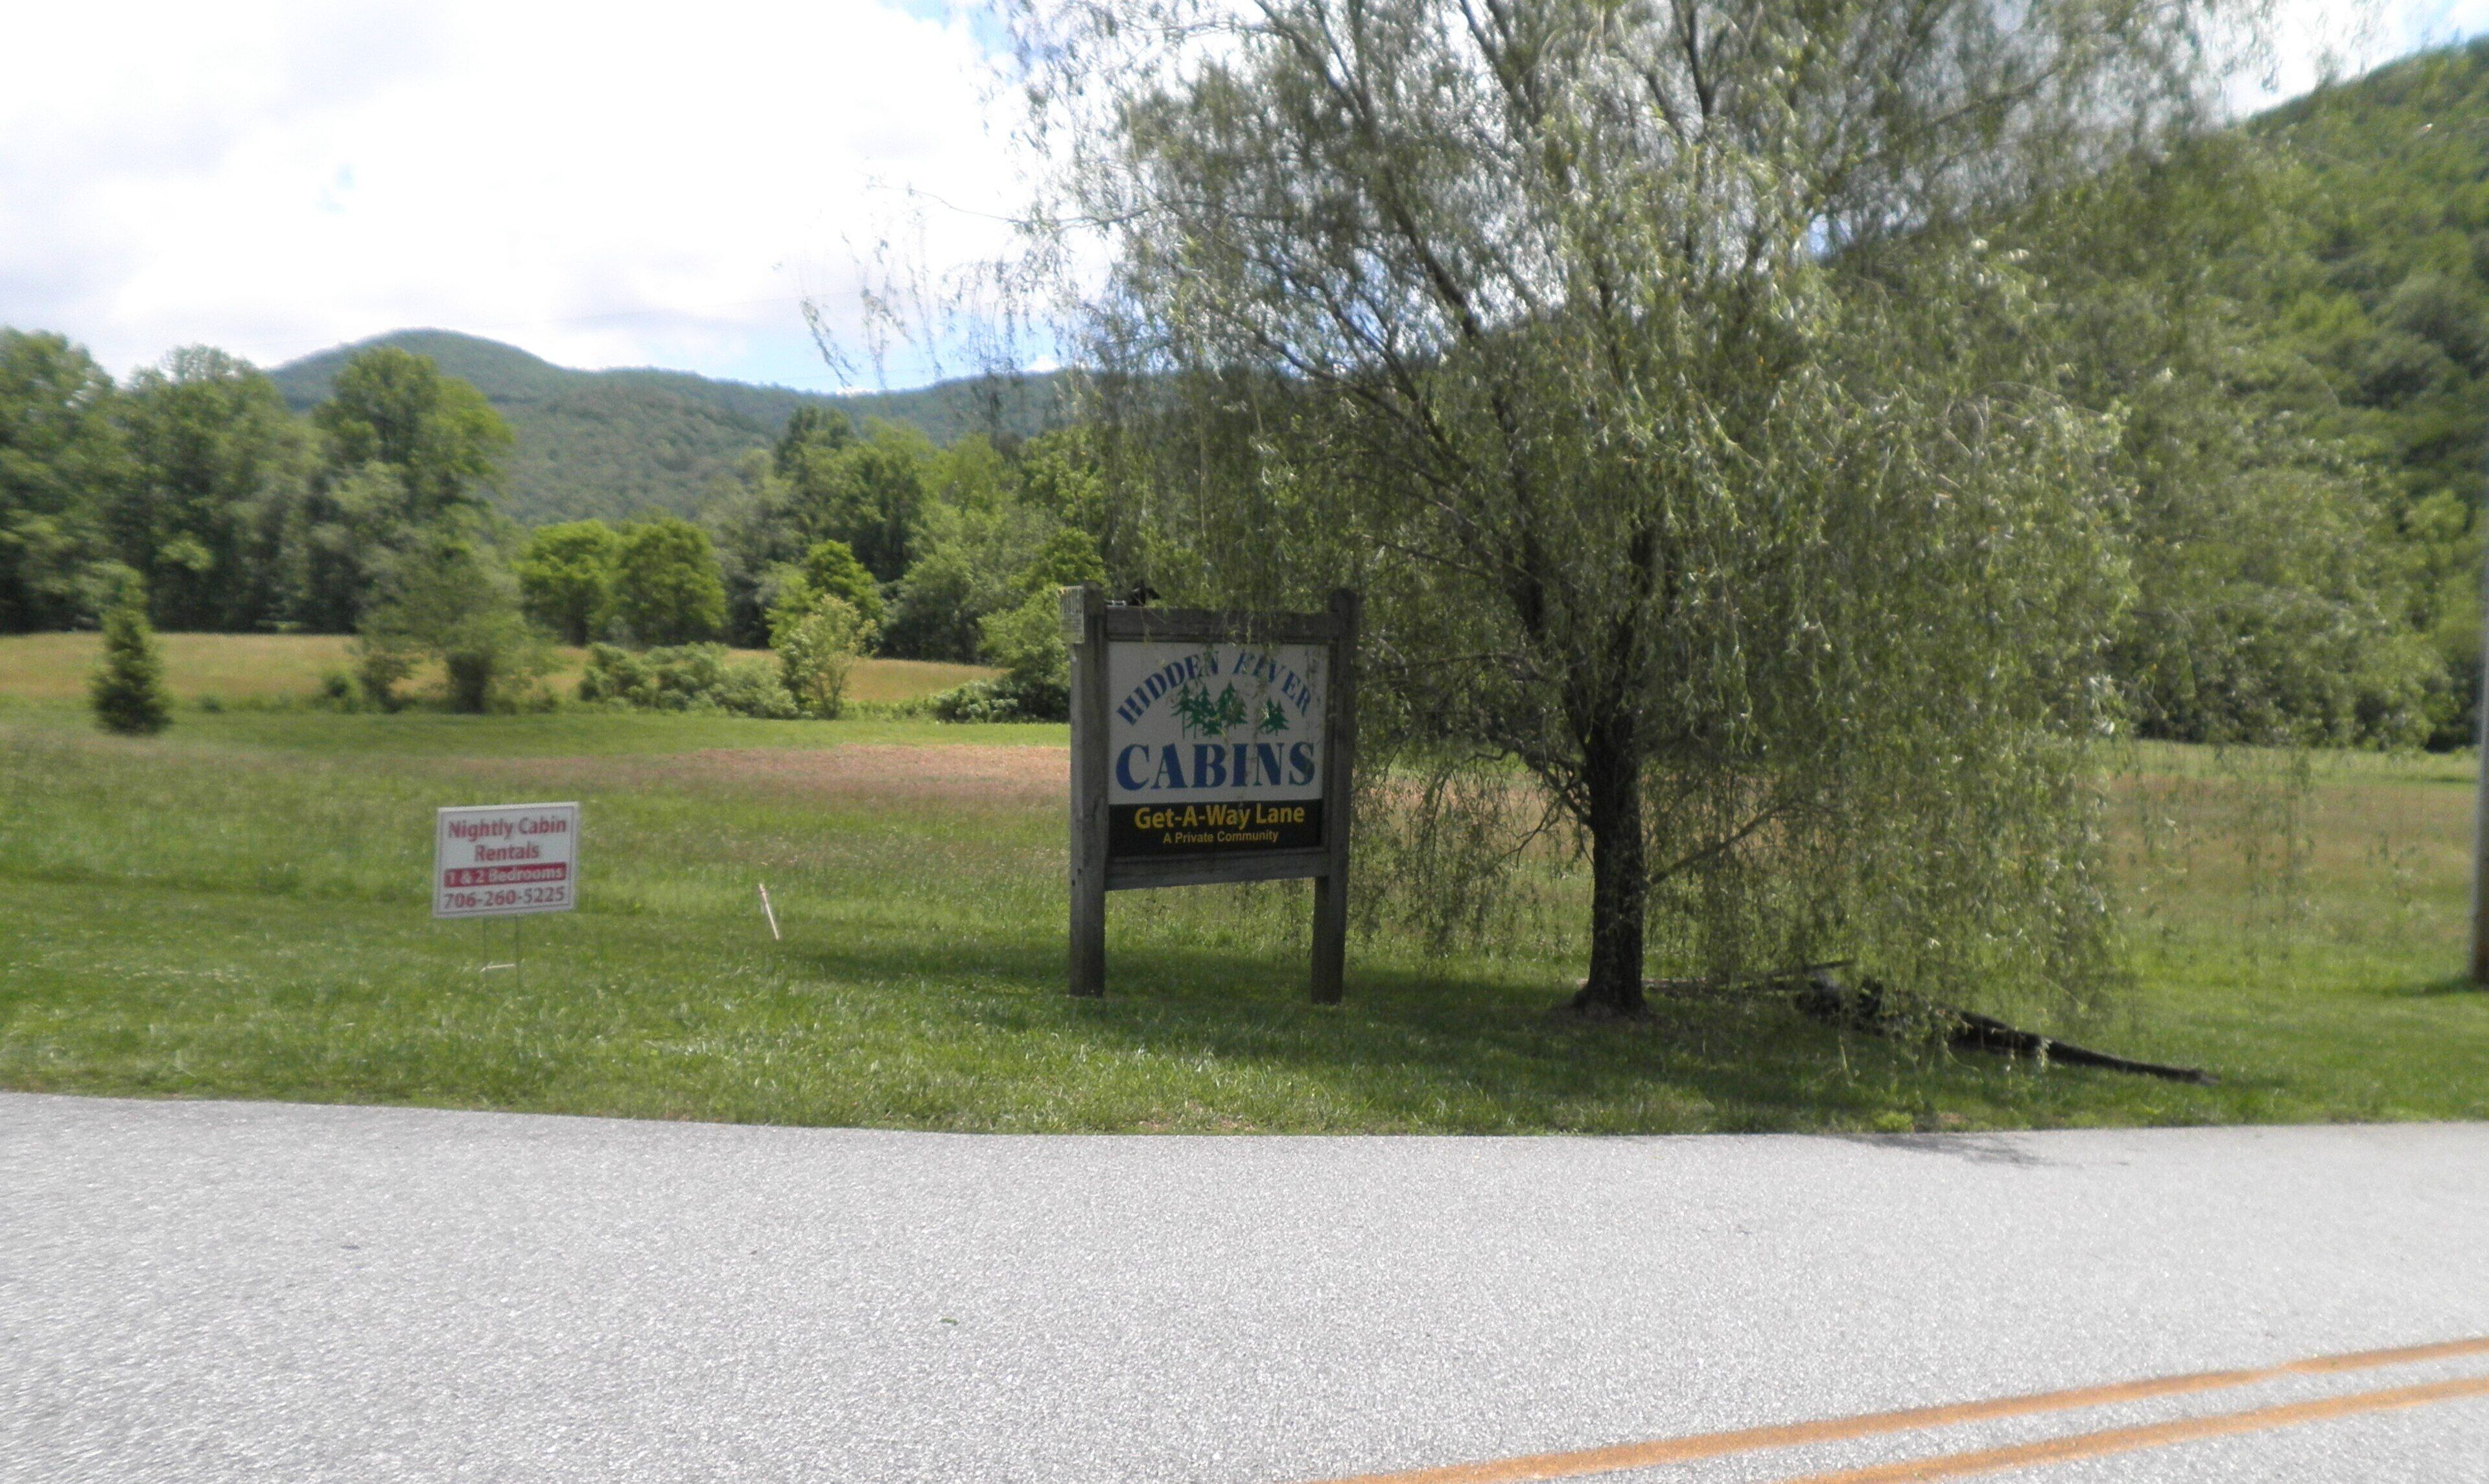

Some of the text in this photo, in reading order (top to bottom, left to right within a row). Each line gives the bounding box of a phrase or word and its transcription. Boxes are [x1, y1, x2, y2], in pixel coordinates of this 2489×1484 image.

[1116, 650, 1219, 725] HIDDEN
[1116, 741, 1315, 791] CABINS
[448, 815, 567, 842] Nightly Cabin
[1134, 803, 1305, 830] Get-A-Way Lane
[1163, 829, 1279, 844] A Private Community
[474, 842, 539, 862] Rentals
[449, 866, 563, 884] 1 & 2 Bedrooms
[443, 886, 565, 908] 706-260-5225
